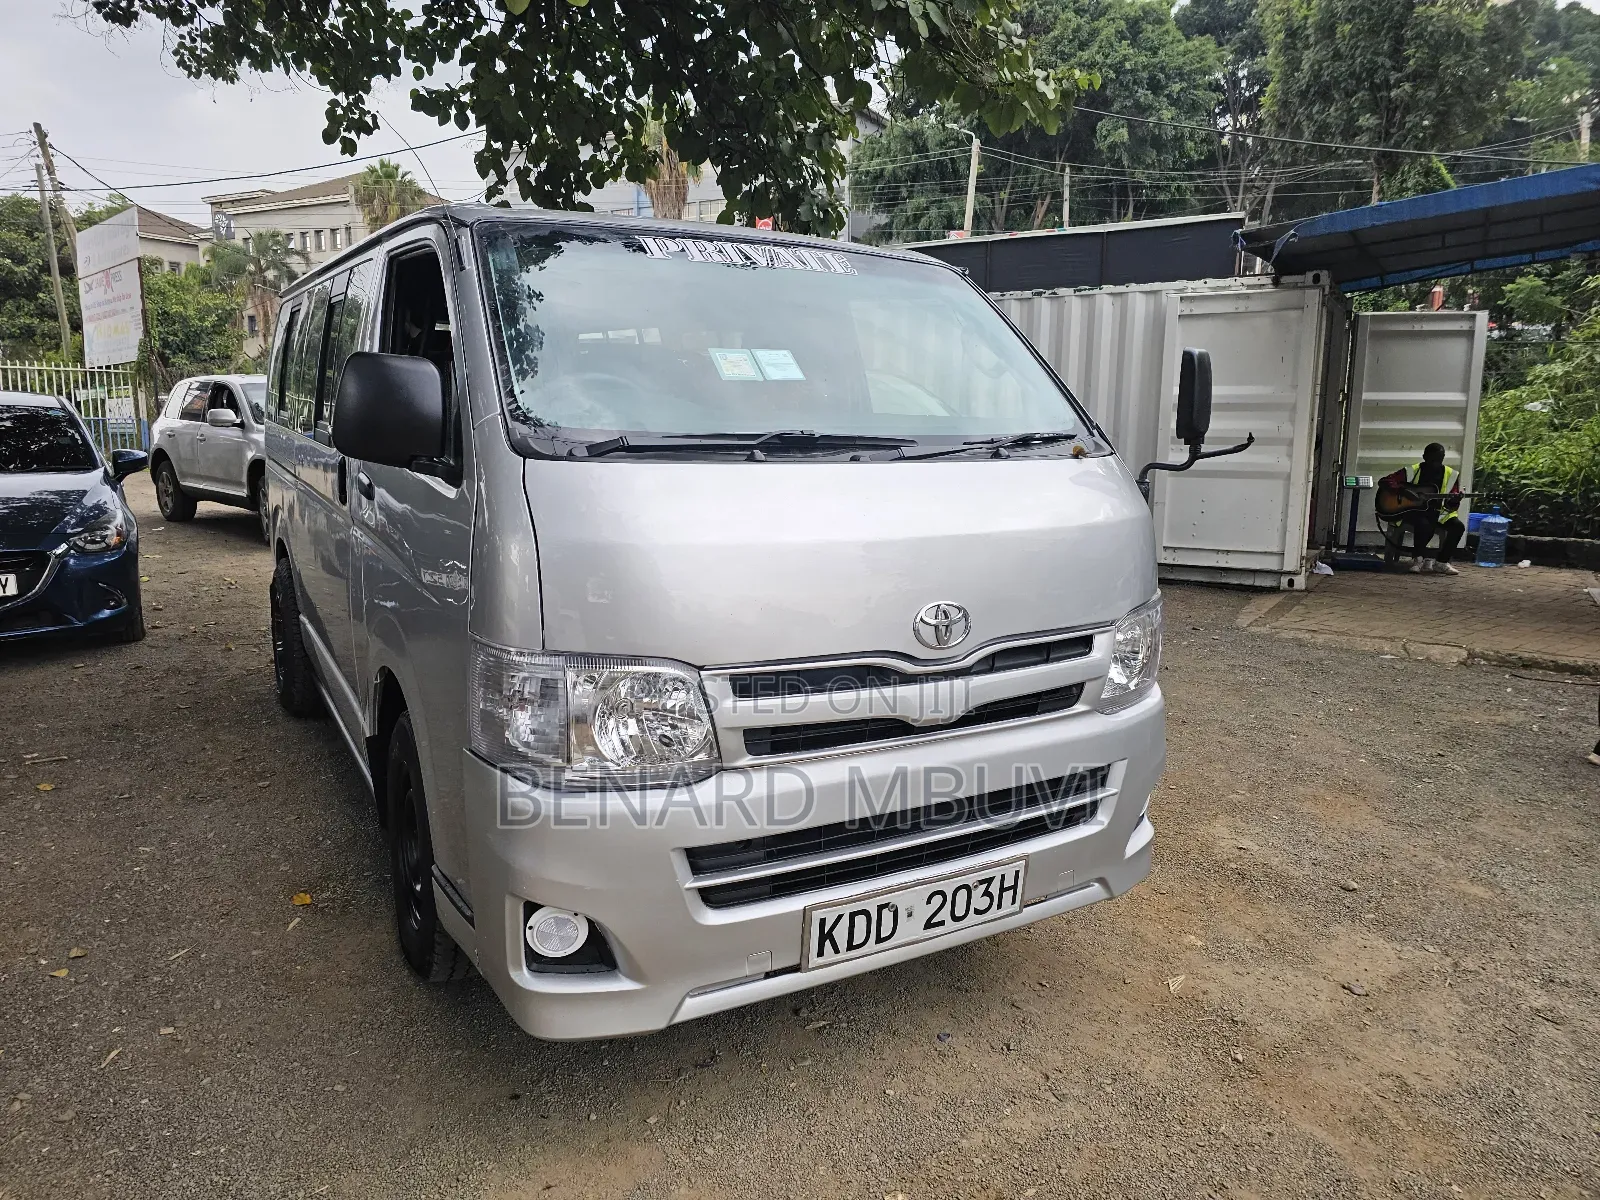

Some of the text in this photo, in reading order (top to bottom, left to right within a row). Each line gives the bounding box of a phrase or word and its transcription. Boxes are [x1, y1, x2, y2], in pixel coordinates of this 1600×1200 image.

[635, 236, 858, 275] PRIVATE
[817, 869, 1020, 958] KDD 203H
